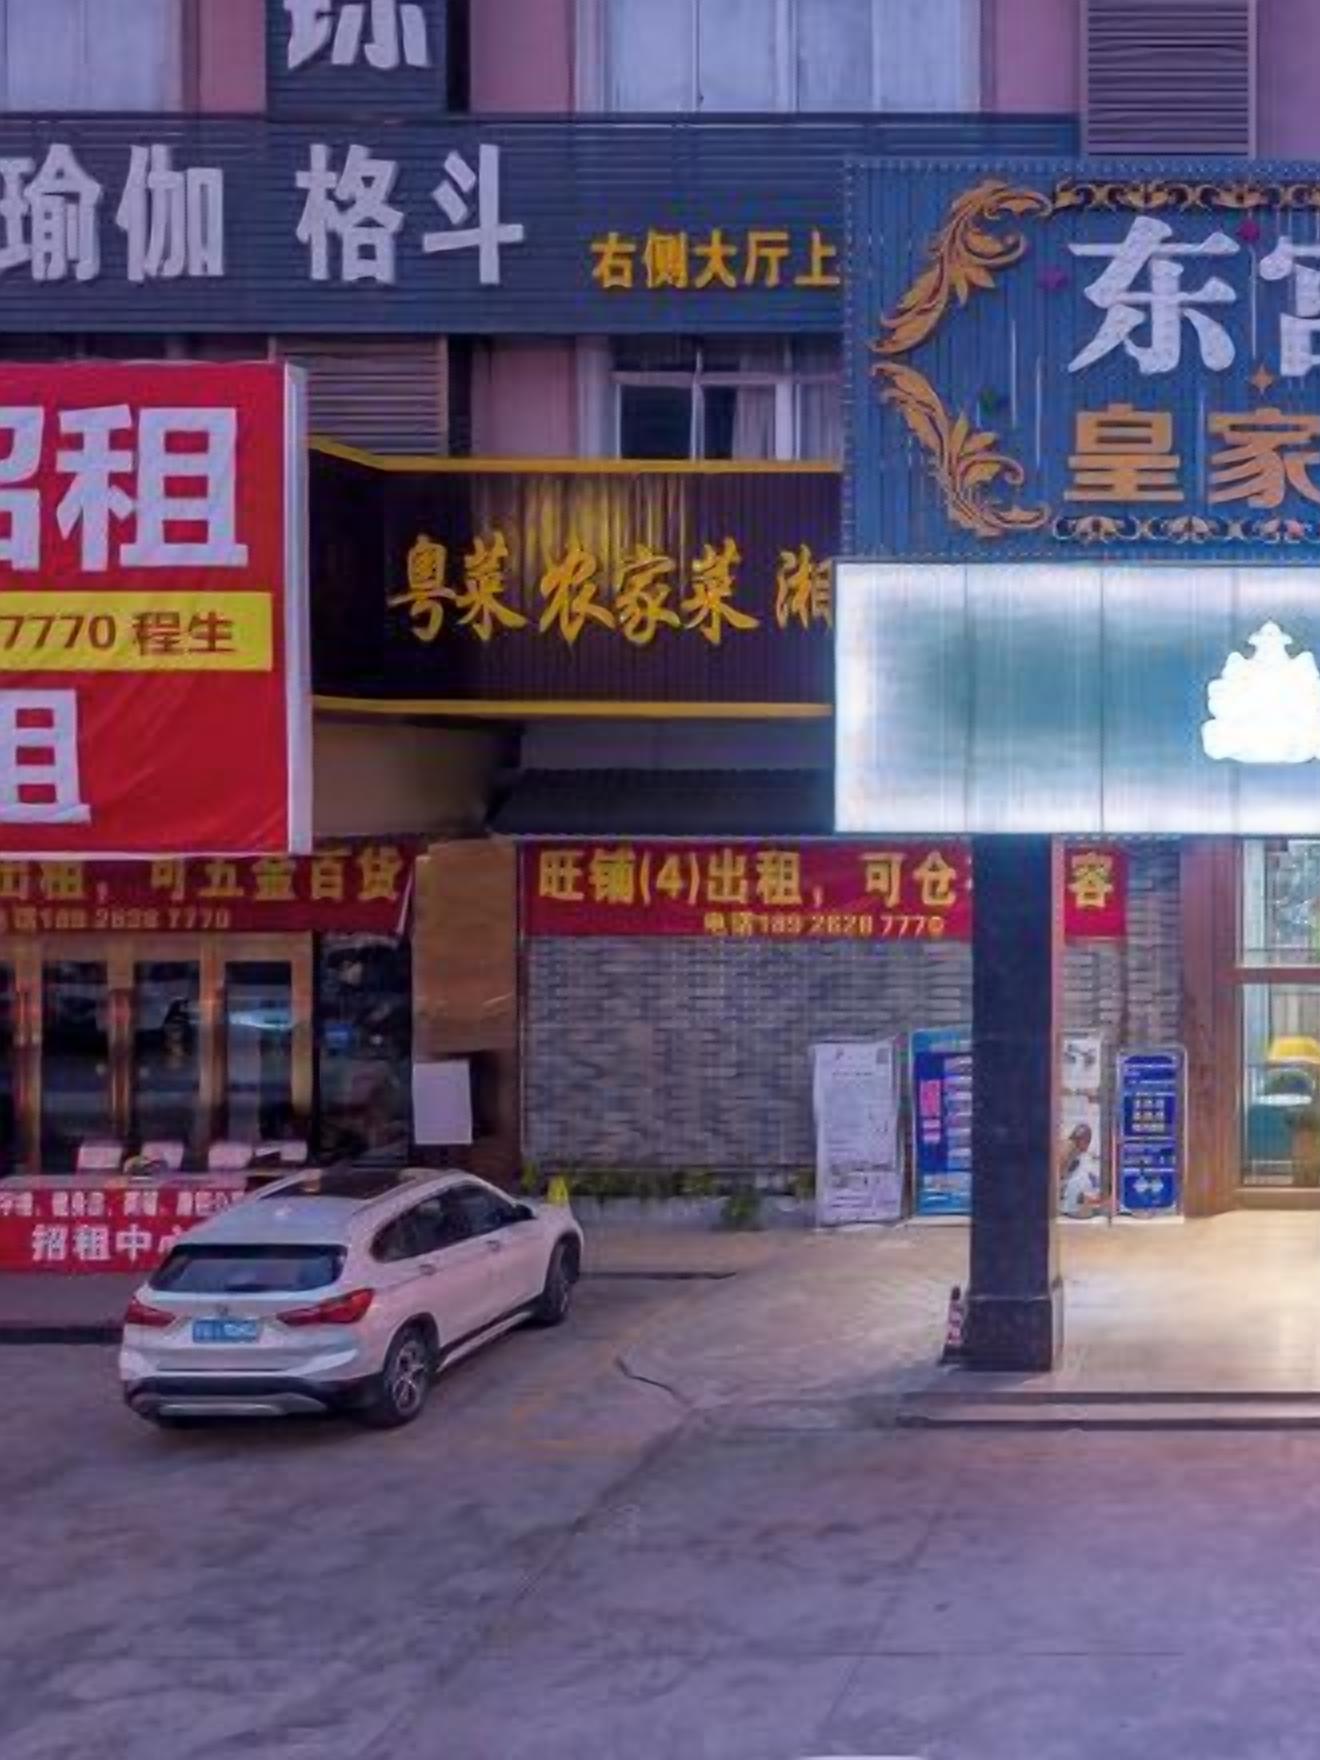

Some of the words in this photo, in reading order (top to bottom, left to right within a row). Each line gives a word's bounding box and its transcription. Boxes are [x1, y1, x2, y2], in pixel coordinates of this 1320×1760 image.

[0, 143, 224, 282] 瑜伽
[295, 143, 524, 286] 格斗
[590, 229, 841, 291] 右侧大厅上
[0, 403, 249, 573] 租
[0, 614, 117, 651] 7770
[132, 610, 238, 656] 程生
[386, 533, 526, 642] 粤菜
[538, 536, 760, 648] 农家菜
